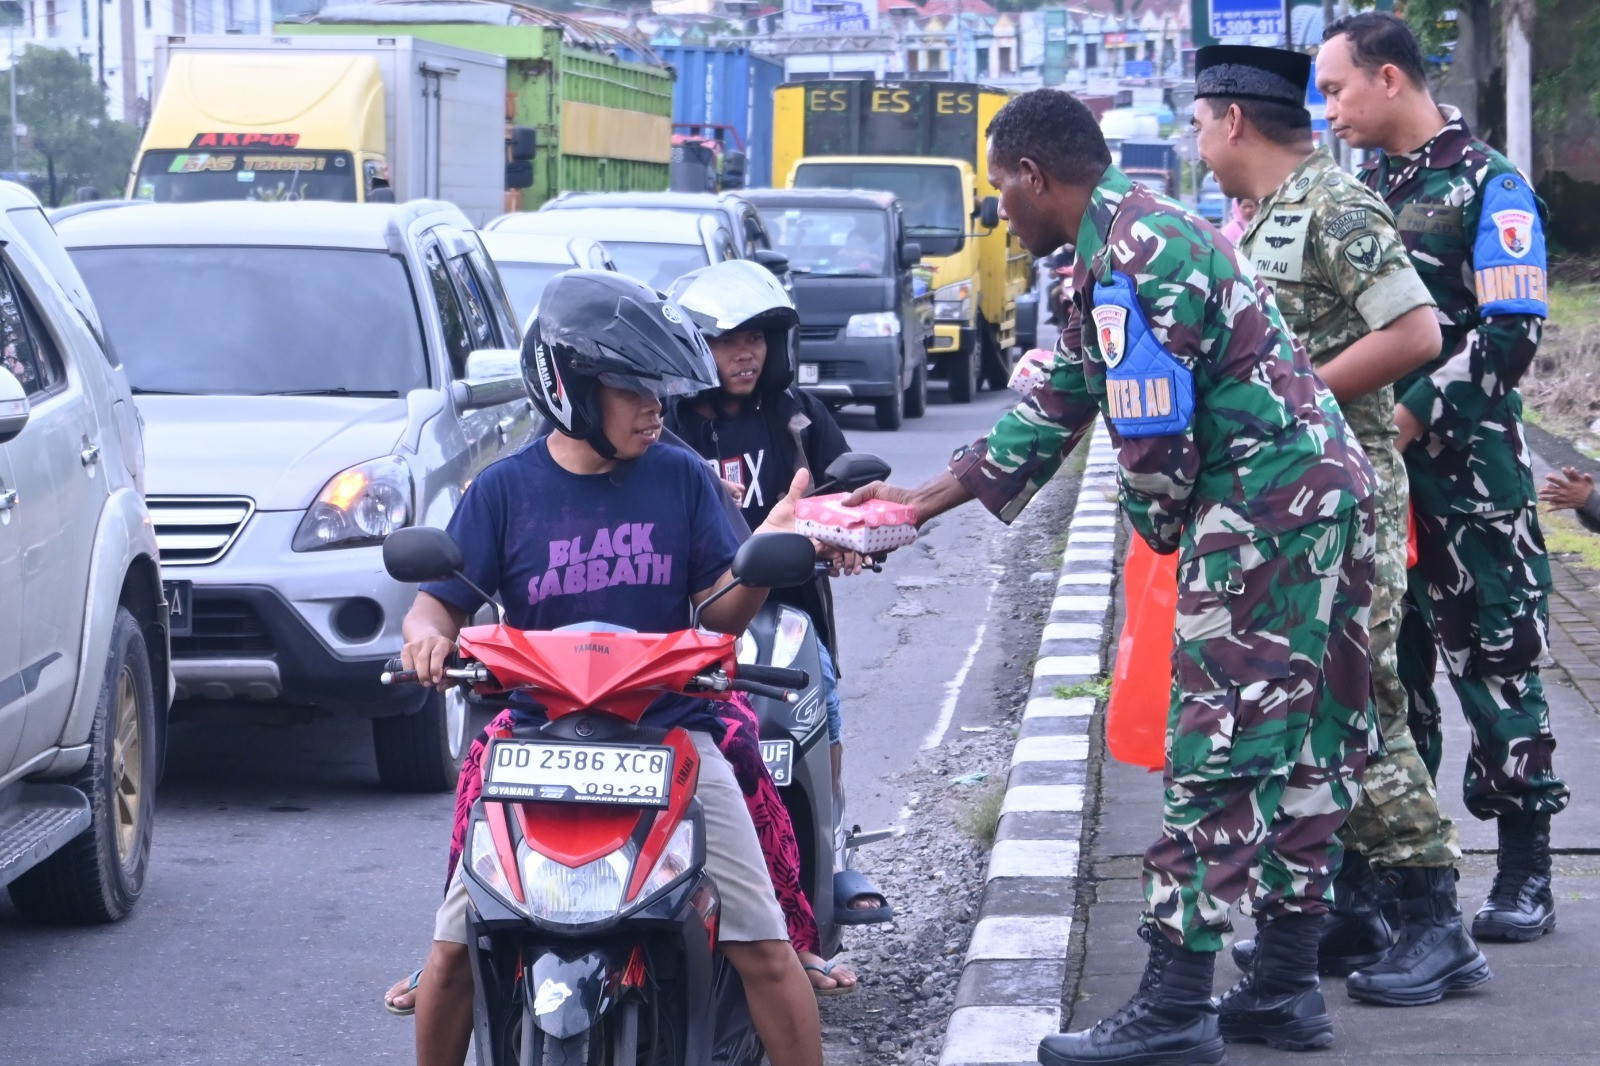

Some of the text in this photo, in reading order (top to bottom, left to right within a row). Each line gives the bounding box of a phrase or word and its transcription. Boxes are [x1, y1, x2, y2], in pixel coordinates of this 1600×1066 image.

[810, 90, 847, 112] ES
[871, 90, 911, 113] ES
[937, 92, 973, 114] ES
[198, 133, 300, 147] AKP-03
[1257, 259, 1288, 274] TNI AU
[536, 344, 553, 389] YAMAHA
[1144, 377, 1172, 418] AU
[548, 523, 655, 570] BLACK
[528, 552, 673, 605] SABBATH
[574, 643, 610, 655] YAMAHA
[497, 747, 531, 769] DD
[539, 749, 605, 771] 2586
[762, 744, 789, 763] UF
[674, 756, 695, 787] YAMAHA
[499, 786, 534, 797] YAMAHA
